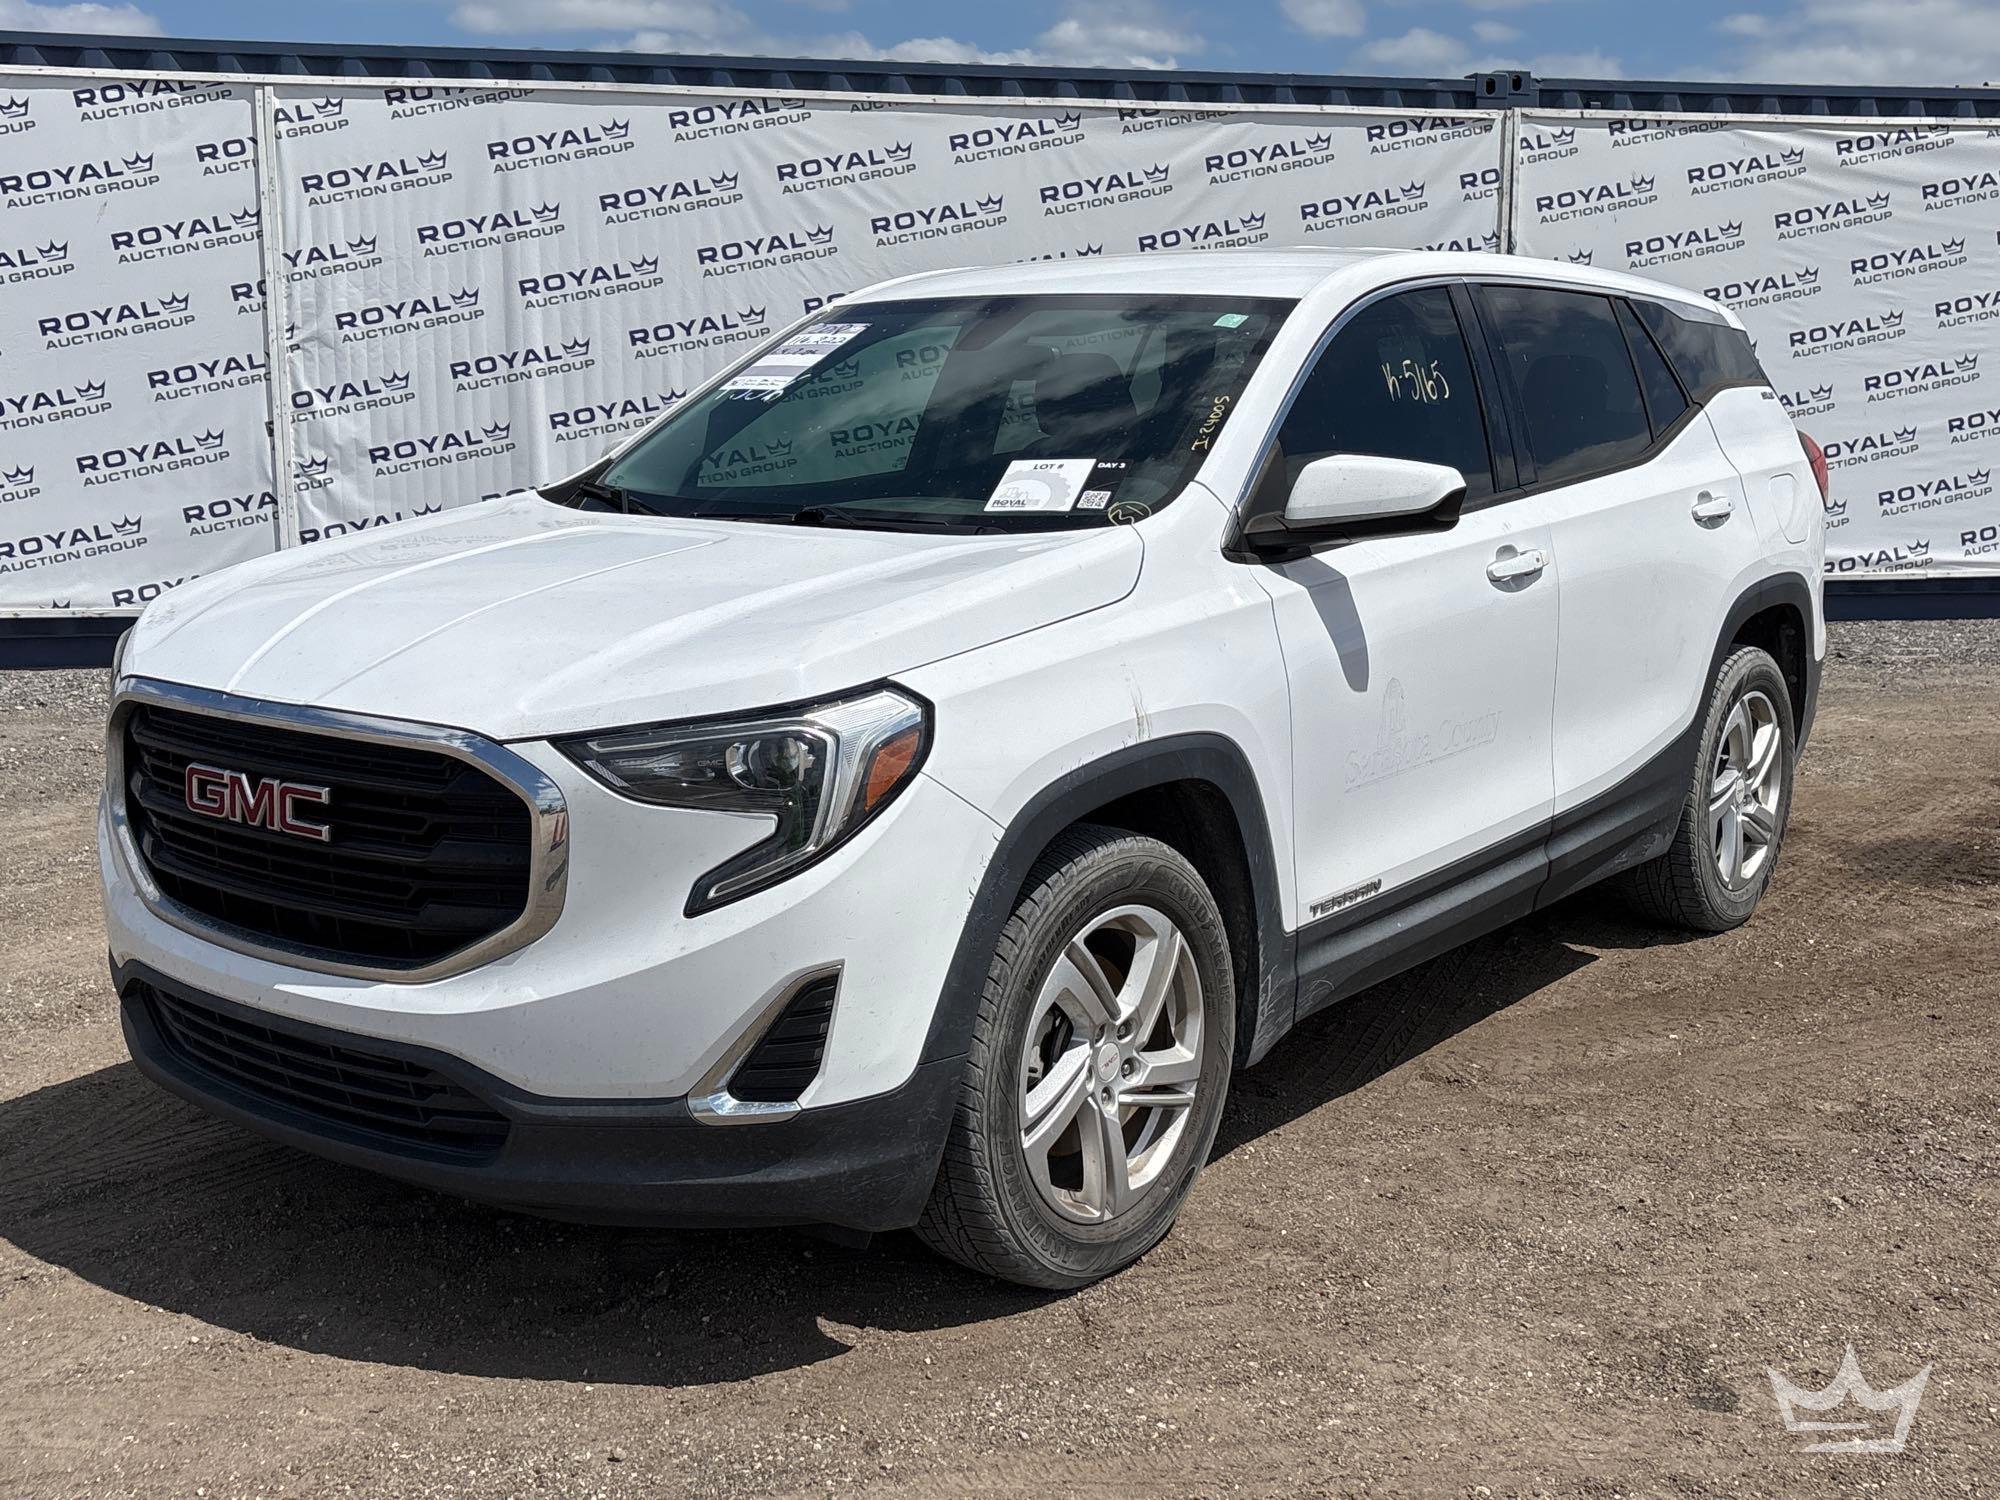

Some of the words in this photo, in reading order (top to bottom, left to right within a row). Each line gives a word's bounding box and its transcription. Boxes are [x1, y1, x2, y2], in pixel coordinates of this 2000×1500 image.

[73, 80, 196, 108] ROYAL
[81, 100, 164, 122] AUCTION
[167, 90, 232, 108] GROUP
[391, 98, 469, 120] AUCTION
[473, 89, 535, 104] GROUP
[668, 98, 779, 129] ROYAL
[675, 122, 749, 142] AUCTION
[753, 112, 811, 129] GROUP
[1121, 113, 1191, 134] AUCTION
[286, 119, 349, 139] GROUP
[487, 127, 601, 160] ROYAL
[949, 120, 1055, 151] ROYAL
[1367, 117, 1465, 142] ROYAL
[1371, 135, 1437, 155] AUCTION
[1441, 124, 1493, 142] GROUP
[1612, 130, 1675, 148] AUCTION
[1679, 121, 1728, 135] GROUP
[1836, 126, 1928, 155] ROYAL
[494, 152, 570, 173] AUCTION
[574, 142, 634, 159] GROUP
[954, 144, 1025, 164] AUCTION
[1029, 134, 1084, 151] GROUP
[1205, 141, 1306, 172] ROYAL
[1528, 147, 1579, 164] GROUP
[1840, 148, 1902, 167] AUCTION
[1905, 138, 1954, 154] GROUP
[0, 161, 124, 194] ROYAL
[301, 159, 419, 193] ROYAL
[777, 150, 885, 181] ROYAL
[783, 174, 855, 194] AUCTION
[859, 164, 916, 181] GROUP
[1209, 165, 1277, 185] AUCTION
[1281, 154, 1334, 171] GROUP
[1688, 155, 1780, 184] ROYAL
[7, 187, 91, 208] AUCTION
[94, 175, 159, 194] GROUP
[309, 184, 387, 207] AUCTION
[391, 173, 452, 191] GROUP
[599, 179, 711, 212] ROYAL
[1040, 172, 1143, 203] ROYAL
[1691, 177, 1754, 195] AUCTION
[1757, 167, 1806, 183] GROUP
[1922, 170, 2000, 199] ROYA
[605, 204, 680, 225] AUCTION
[684, 194, 743, 211] GROUP
[1044, 196, 1114, 216] AUCTION
[1118, 185, 1173, 202] GROUP
[1301, 189, 1400, 220] ROYAL
[1536, 183, 1632, 212] ROYAL
[1540, 205, 1604, 224] AUCTION
[1608, 195, 1657, 211] GROUP
[1925, 192, 1987, 212] AUCTION
[417, 210, 532, 244] ROYAL
[871, 202, 977, 234] ROYAL
[1304, 212, 1372, 233] AUCTION
[1375, 202, 1428, 219] GROUP
[1775, 199, 1866, 229] ROYAL
[1778, 221, 1840, 240] AUCTION
[1843, 211, 1892, 227] GROUP
[111, 216, 232, 250] ROYAL
[424, 236, 501, 257] AUCTION
[504, 224, 565, 242] GROUP
[876, 227, 947, 247] AUCTION
[951, 216, 1007, 233] GROUP
[1138, 220, 1240, 252] ROYAL
[1626, 228, 1719, 257] ROYAL
[118, 242, 200, 264] AUCTION
[282, 244, 348, 268] YAL
[697, 233, 806, 265] ROYAL
[703, 257, 776, 278] AUCTION
[780, 247, 837, 264] GROUP
[1629, 250, 1692, 269] AUCTION
[1696, 240, 1745, 256] GROUP
[1851, 245, 1941, 275] ROYAL
[9, 263, 74, 283] GROUP
[321, 256, 382, 276] GROUP
[518, 263, 631, 296] ROYAL
[1854, 267, 1915, 286] AUCTION
[1919, 256, 1967, 273] GROUP
[525, 288, 600, 310] AUCTION
[604, 277, 663, 295] GROUP
[1704, 274, 1795, 301] ROYAL
[1772, 285, 1821, 302] GROUP
[38, 302, 160, 336] ROYAL
[335, 296, 451, 330] ROYAL
[342, 321, 420, 343] AUCTION
[423, 310, 484, 328] GROUP
[1938, 309, 1999, 329] AUCTION
[46, 327, 128, 350] AUCTION
[131, 315, 195, 334] GROUP
[629, 314, 739, 346] ROYAL
[635, 338, 709, 359] AUCTION
[712, 327, 770, 345] GROUP
[1066, 327, 1134, 348] AUCTION
[1790, 318, 1880, 347] ROYAL
[1793, 339, 1854, 358] AUCTION
[1857, 329, 1905, 345] GROUP
[147, 354, 266, 388] ROYAL
[450, 346, 563, 379] ROYAL
[456, 370, 532, 392] AUCTION
[536, 359, 595, 377] GROUP
[1865, 362, 1954, 391] ROYAL
[154, 379, 234, 402] AUCTION
[291, 380, 382, 409] OYAL
[354, 392, 415, 412] GROUP
[807, 381, 864, 397] GROUP
[1867, 383, 1928, 403] AUCTION
[1932, 373, 1980, 389] GROUP
[48, 402, 112, 422] GROUP
[550, 397, 660, 430] ROYAL
[368, 430, 483, 464] ROYAL
[555, 421, 629, 443] AUCTION
[1824, 433, 1893, 459] OYAL
[1950, 426, 2000, 444] AUCTIO
[76, 438, 195, 473] ROYAL
[376, 455, 452, 477] AUCTION
[456, 443, 516, 461] GROUP
[834, 437, 905, 458] AUCTION
[1871, 444, 1919, 461] GROUP
[84, 464, 164, 487] AUCTION
[167, 451, 229, 470] GROUP
[740, 458, 798, 476] GROUP
[0, 487, 40, 502] OUP
[1878, 476, 1967, 506] ROYAL
[1881, 498, 1941, 517] AUCTION
[1945, 487, 1992, 503] GROUP
[182, 491, 278, 523] ROYA
[190, 513, 268, 536] AUCTION
[0, 525, 112, 560] ROYAL
[0, 550, 81, 574] AUCTION
[84, 537, 148, 557] GROUP
[1885, 558, 1933, 572] GROUP
[186, 762, 331, 842] GMC
[1310, 879, 1382, 918] TERRAIN
